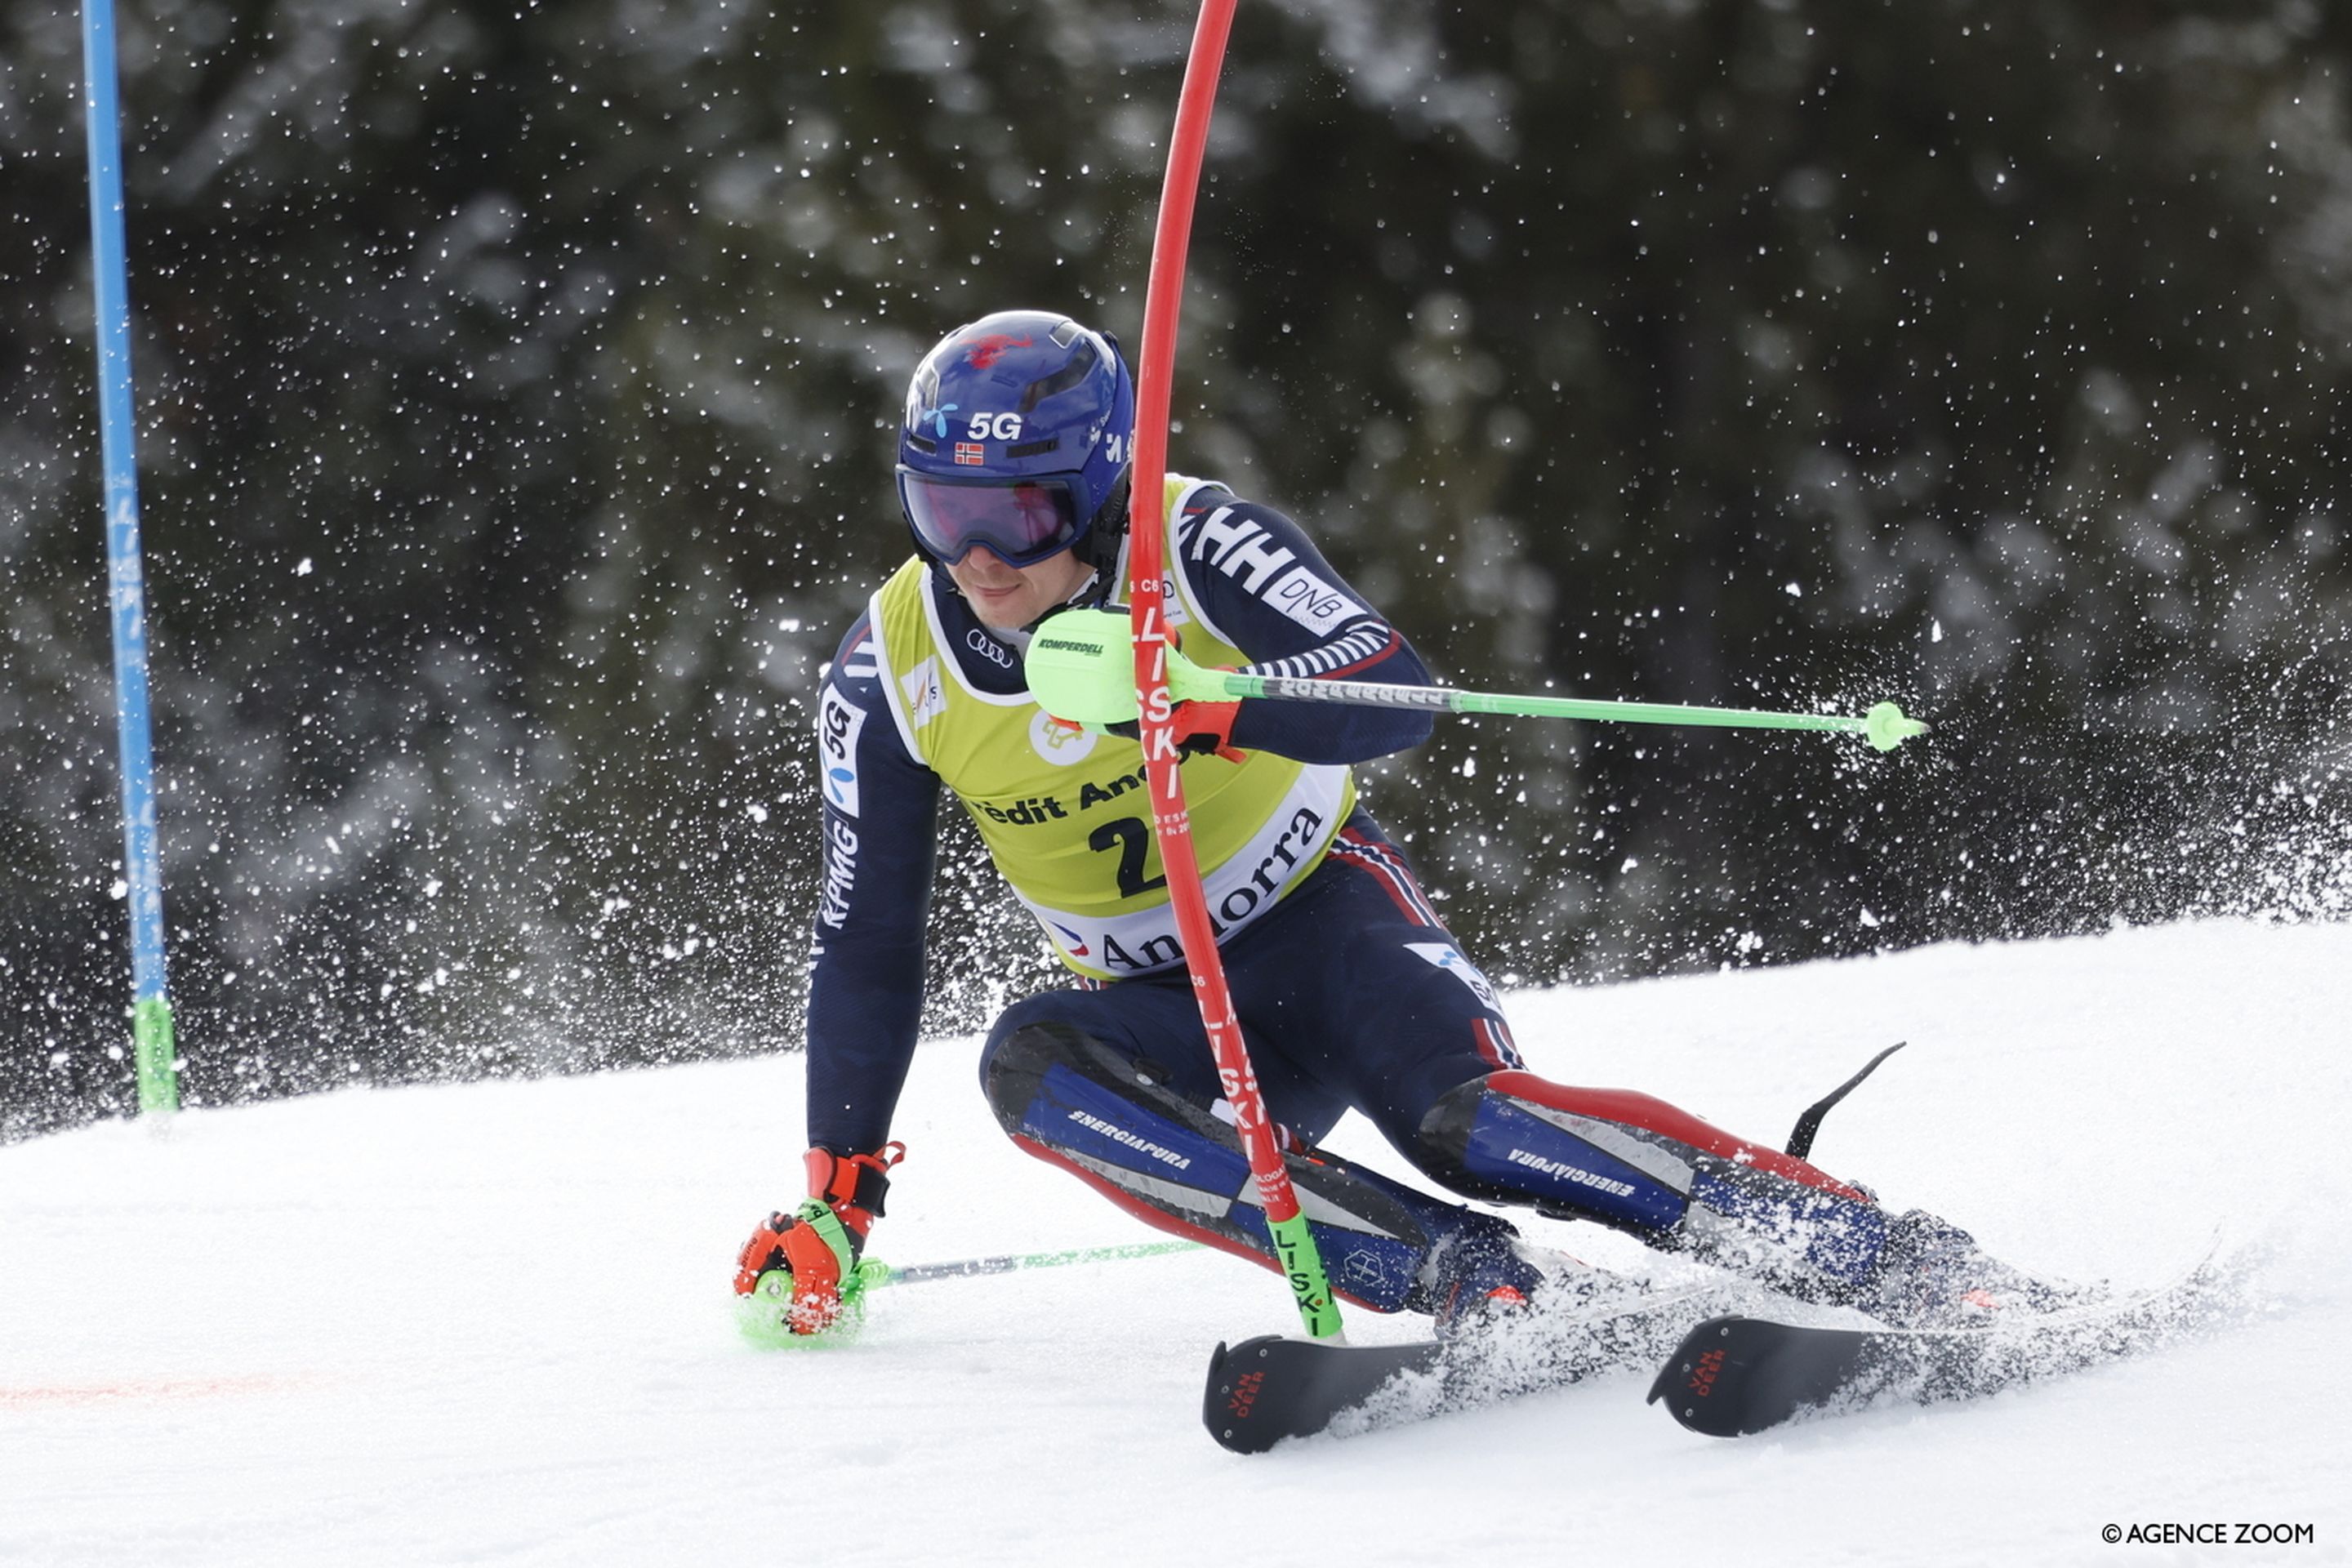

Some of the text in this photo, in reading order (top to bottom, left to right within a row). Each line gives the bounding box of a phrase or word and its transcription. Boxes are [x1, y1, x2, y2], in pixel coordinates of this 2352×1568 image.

[967, 412, 1022, 440] 5G
[1280, 577, 1343, 619] DNB
[1038, 639, 1104, 654] KOMPERDELL
[1140, 607, 1178, 799] LISKI
[825, 701, 852, 760] 5G
[819, 820, 859, 930] KPMG
[1089, 817, 1169, 899] 2
[1102, 805, 1324, 972] Anorra
[1067, 1109, 1192, 1171] ENERGIAPURA
[1276, 1230, 1321, 1337] LISKI
[1227, 1373, 1251, 1409] VAN
[1236, 1371, 1266, 1419] DEER
[1689, 1352, 1713, 1388] VAN
[1698, 1349, 1726, 1396] DEER
